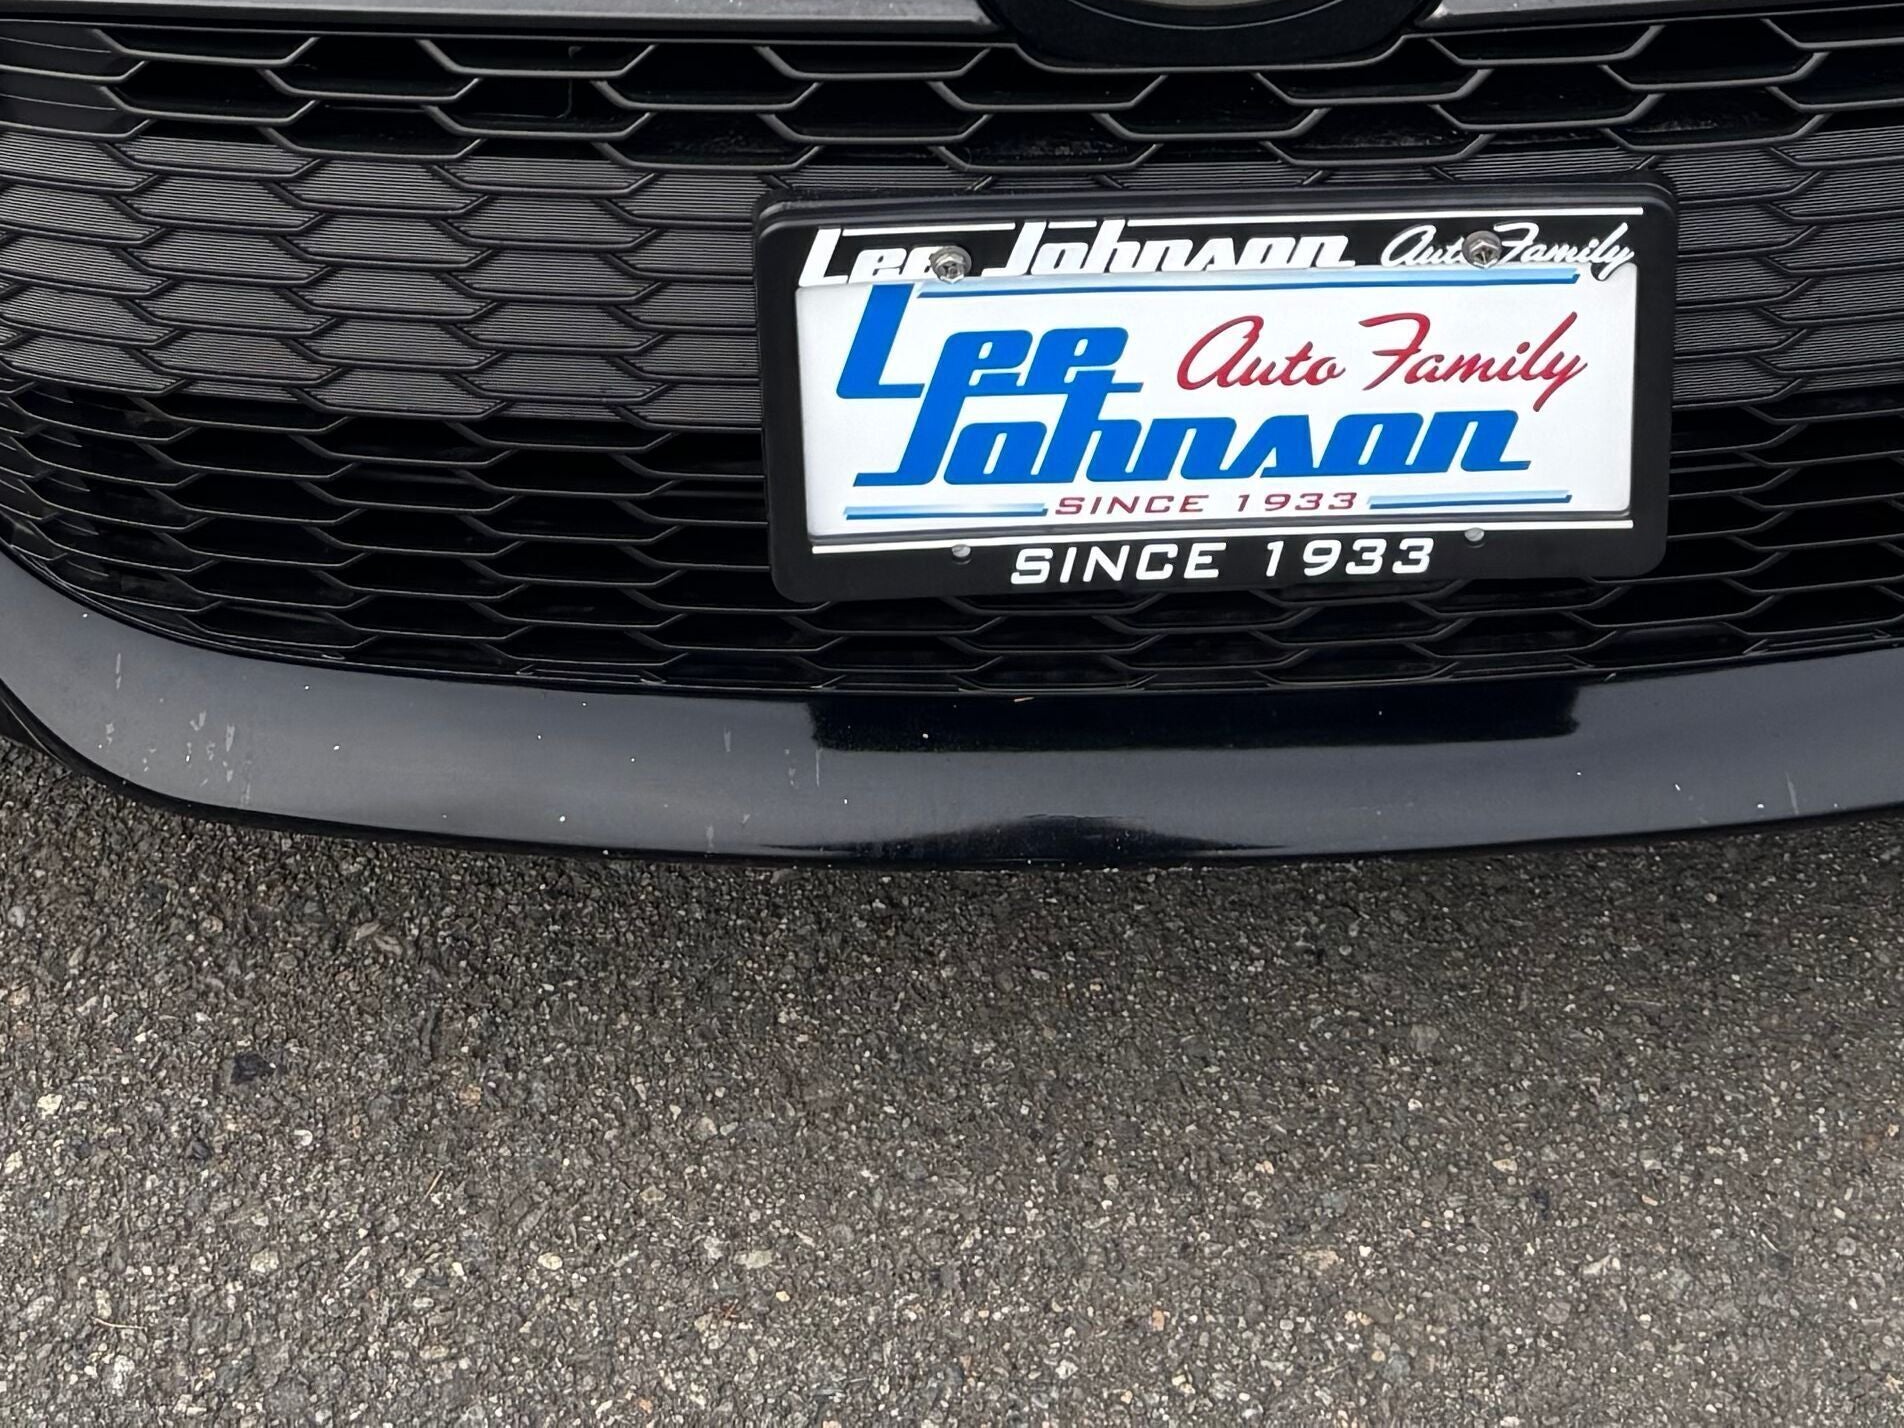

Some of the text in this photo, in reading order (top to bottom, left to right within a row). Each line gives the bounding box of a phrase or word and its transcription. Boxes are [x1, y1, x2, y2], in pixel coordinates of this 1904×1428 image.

[981, 218, 1356, 276] Johnson
[1380, 224, 1470, 267] Aut
[1493, 221, 1635, 281] Family
[836, 282, 1144, 400] Lee
[1177, 311, 1588, 413] Auto Family
[853, 370, 1532, 487] Johnson
[1054, 492, 1358, 515] SINCE 1933
[1009, 537, 1436, 585] SINCE 1933
